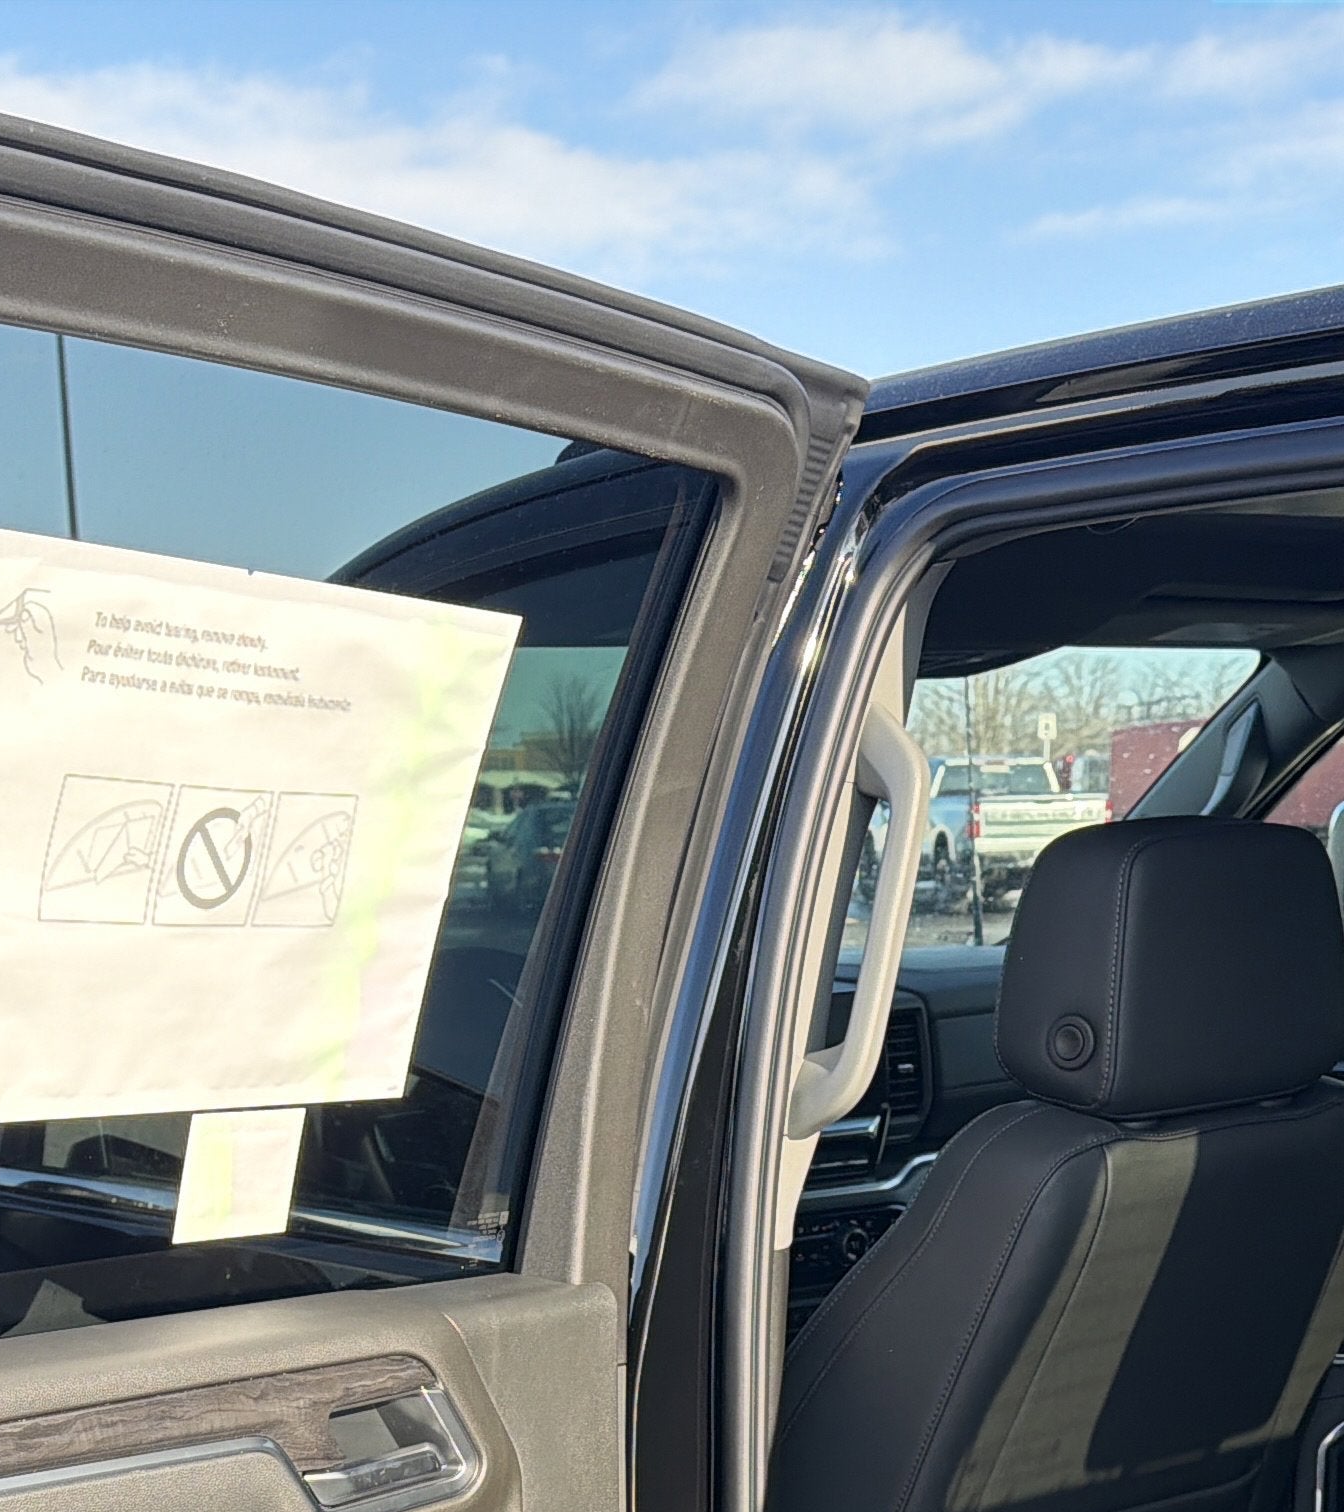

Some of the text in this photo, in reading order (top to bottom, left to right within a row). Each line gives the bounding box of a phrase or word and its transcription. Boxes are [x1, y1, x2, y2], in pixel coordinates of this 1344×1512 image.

[95, 611, 108, 628] To
[109, 613, 132, 633] help
[133, 619, 163, 636] avoid
[87, 639, 112, 656] Pour
[113, 641, 144, 661] éviter
[81, 665, 107, 683] Para
[108, 673, 157, 690] ayudarse
[160, 680, 167, 692] a
[196, 684, 215, 699] que
[216, 687, 228, 699] se
